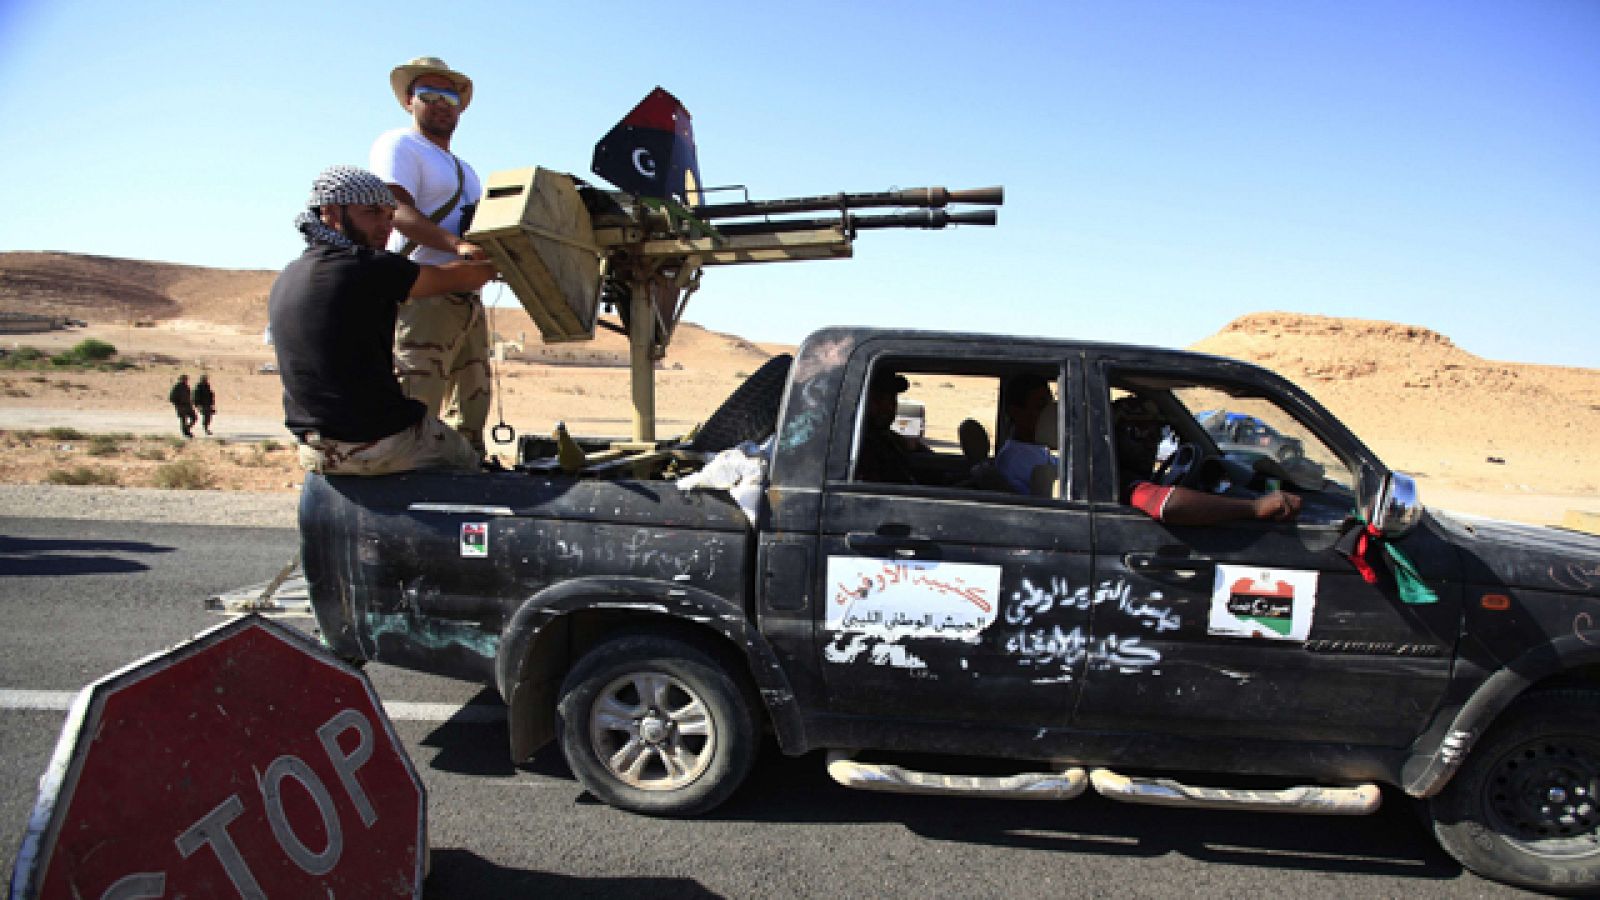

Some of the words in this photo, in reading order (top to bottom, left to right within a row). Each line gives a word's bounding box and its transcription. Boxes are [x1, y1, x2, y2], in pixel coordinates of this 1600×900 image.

[885, 612, 933, 630] الوطني
[934, 614, 986, 632] الجيش
[101, 709, 379, 900] TOP
